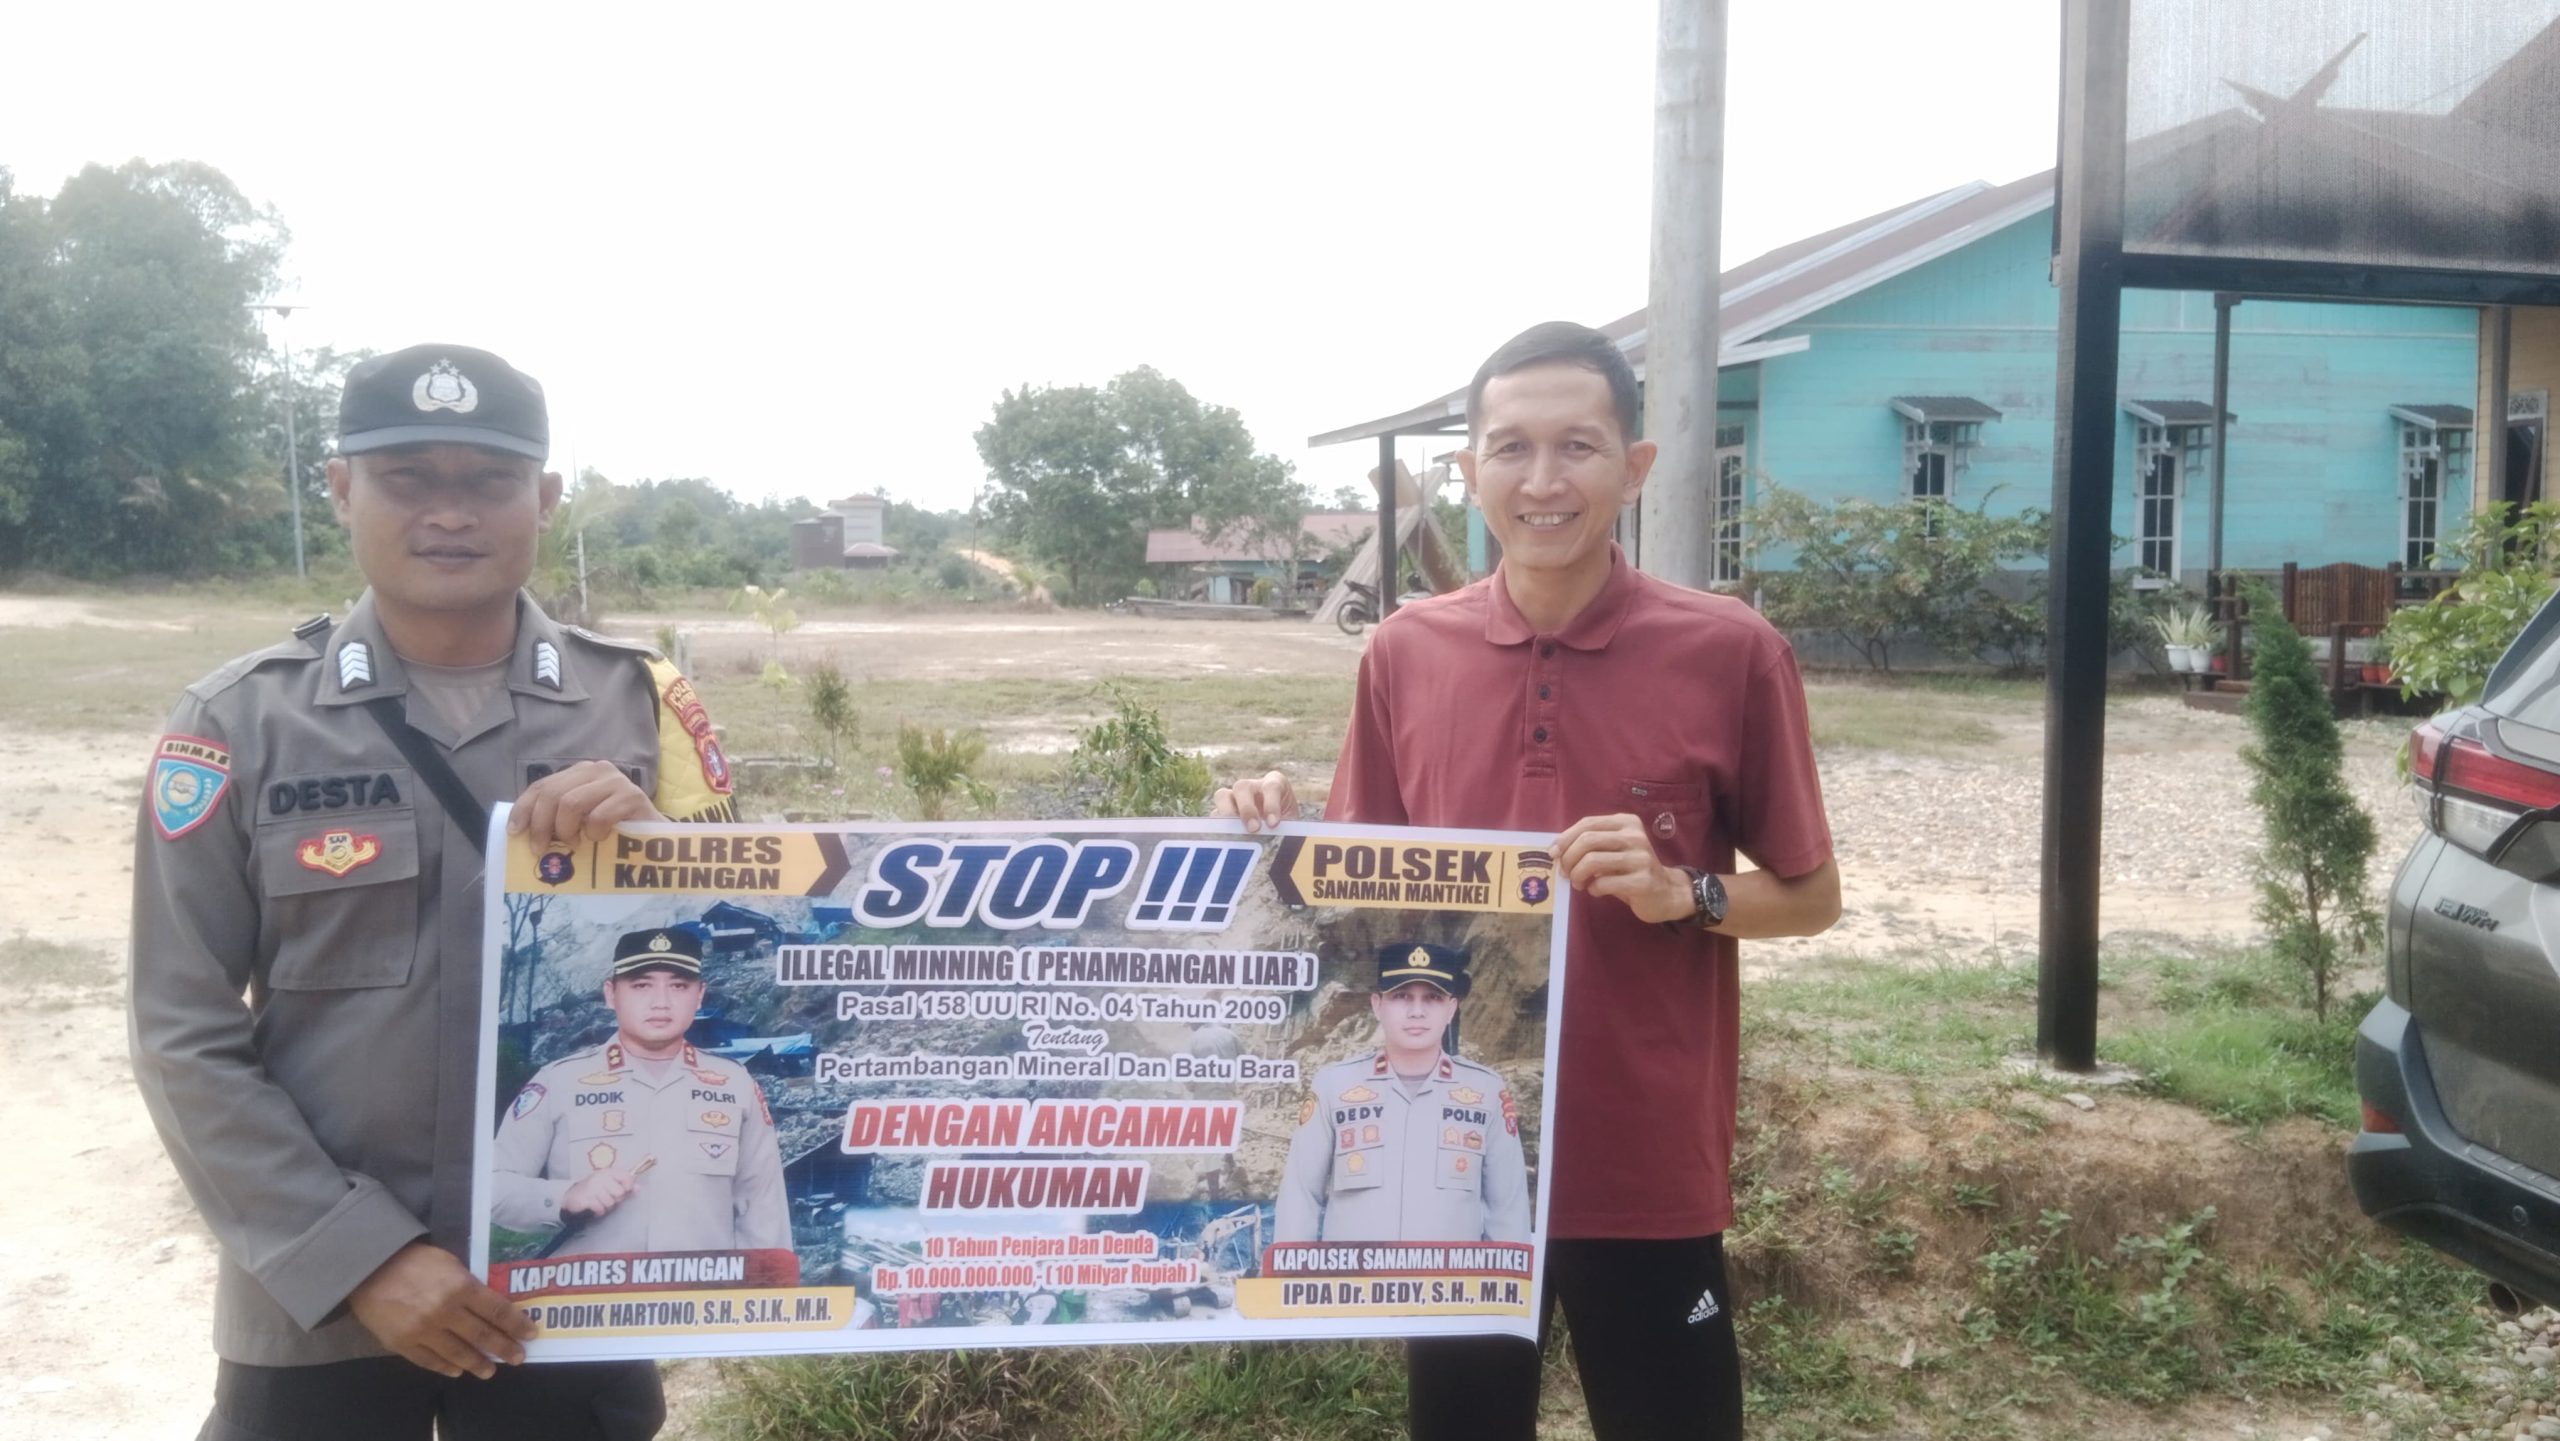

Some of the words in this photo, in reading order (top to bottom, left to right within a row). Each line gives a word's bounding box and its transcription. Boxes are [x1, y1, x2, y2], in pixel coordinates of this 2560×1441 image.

[268, 773, 401, 815] DESTA
[616, 833, 783, 864] POLRES
[614, 863, 780, 890] KATINGAN
[1312, 844, 1493, 884] POLSEK
[861, 843, 1134, 921] STOP
[1312, 878, 1400, 902] SANAMAN
[1404, 881, 1490, 905] MANTIKEI
[781, 949, 886, 981] ILLEGAL
[893, 949, 1014, 981] MINNING
[1037, 950, 1236, 985] PENAMBANGAN
[1242, 954, 1298, 987] LIAR
[841, 995, 913, 1017] Pasal
[922, 995, 966, 1016] 158
[974, 996, 1013, 1016] UU
[1021, 996, 1047, 1016] RI
[1055, 997, 1096, 1017] No.
[1105, 997, 1134, 1018] 04
[1142, 997, 1217, 1019] Tahun
[1224, 1000, 1282, 1020] 2009
[1027, 1023, 1106, 1050] Tentang
[820, 1055, 1009, 1081] Pertambangan
[1017, 1055, 1110, 1077] Mineral
[1118, 1057, 1167, 1077] Dan
[1175, 1058, 1232, 1079] Batu
[1240, 1059, 1296, 1079] Bara
[575, 1091, 624, 1106] DODIK
[691, 1089, 736, 1105] POLRI
[847, 1104, 1024, 1149] DENGAN
[1027, 1105, 1238, 1149] ANCAMAN
[1335, 1106, 1385, 1124] DEDY
[1442, 1107, 1487, 1126] POLRI
[925, 1166, 1146, 1210] HUKUMAN
[926, 1236, 944, 1258] 10
[947, 1237, 998, 1257] Tahun
[1002, 1235, 1065, 1258] Penjara
[1068, 1235, 1099, 1256] Dan
[1103, 1233, 1154, 1255] Denda
[1273, 1248, 1360, 1272] KAPOLSEK
[1362, 1247, 1445, 1270] SANAMAN
[1449, 1248, 1529, 1273] MANTIKEI
[510, 1259, 627, 1294] KAPOLRES
[632, 1255, 745, 1285] KATINGAN
[876, 1267, 902, 1291] Rp.
[1077, 1263, 1129, 1286] Milyar
[1131, 1262, 1187, 1285] Rupiah
[1282, 1282, 1333, 1306] IPDA
[1338, 1281, 1366, 1305] Dr.
[1370, 1281, 1426, 1306] DEDY,
[1431, 1281, 1474, 1306] S.H.,
[1480, 1281, 1524, 1306] M.H.
[546, 1304, 605, 1329] DODIK
[609, 1301, 699, 1328] HARTONO,
[703, 1299, 740, 1326] S.H.,
[744, 1299, 791, 1325] S.I.K.,
[795, 1298, 832, 1322] M.H.
[1687, 1303, 1720, 1325] adidas
